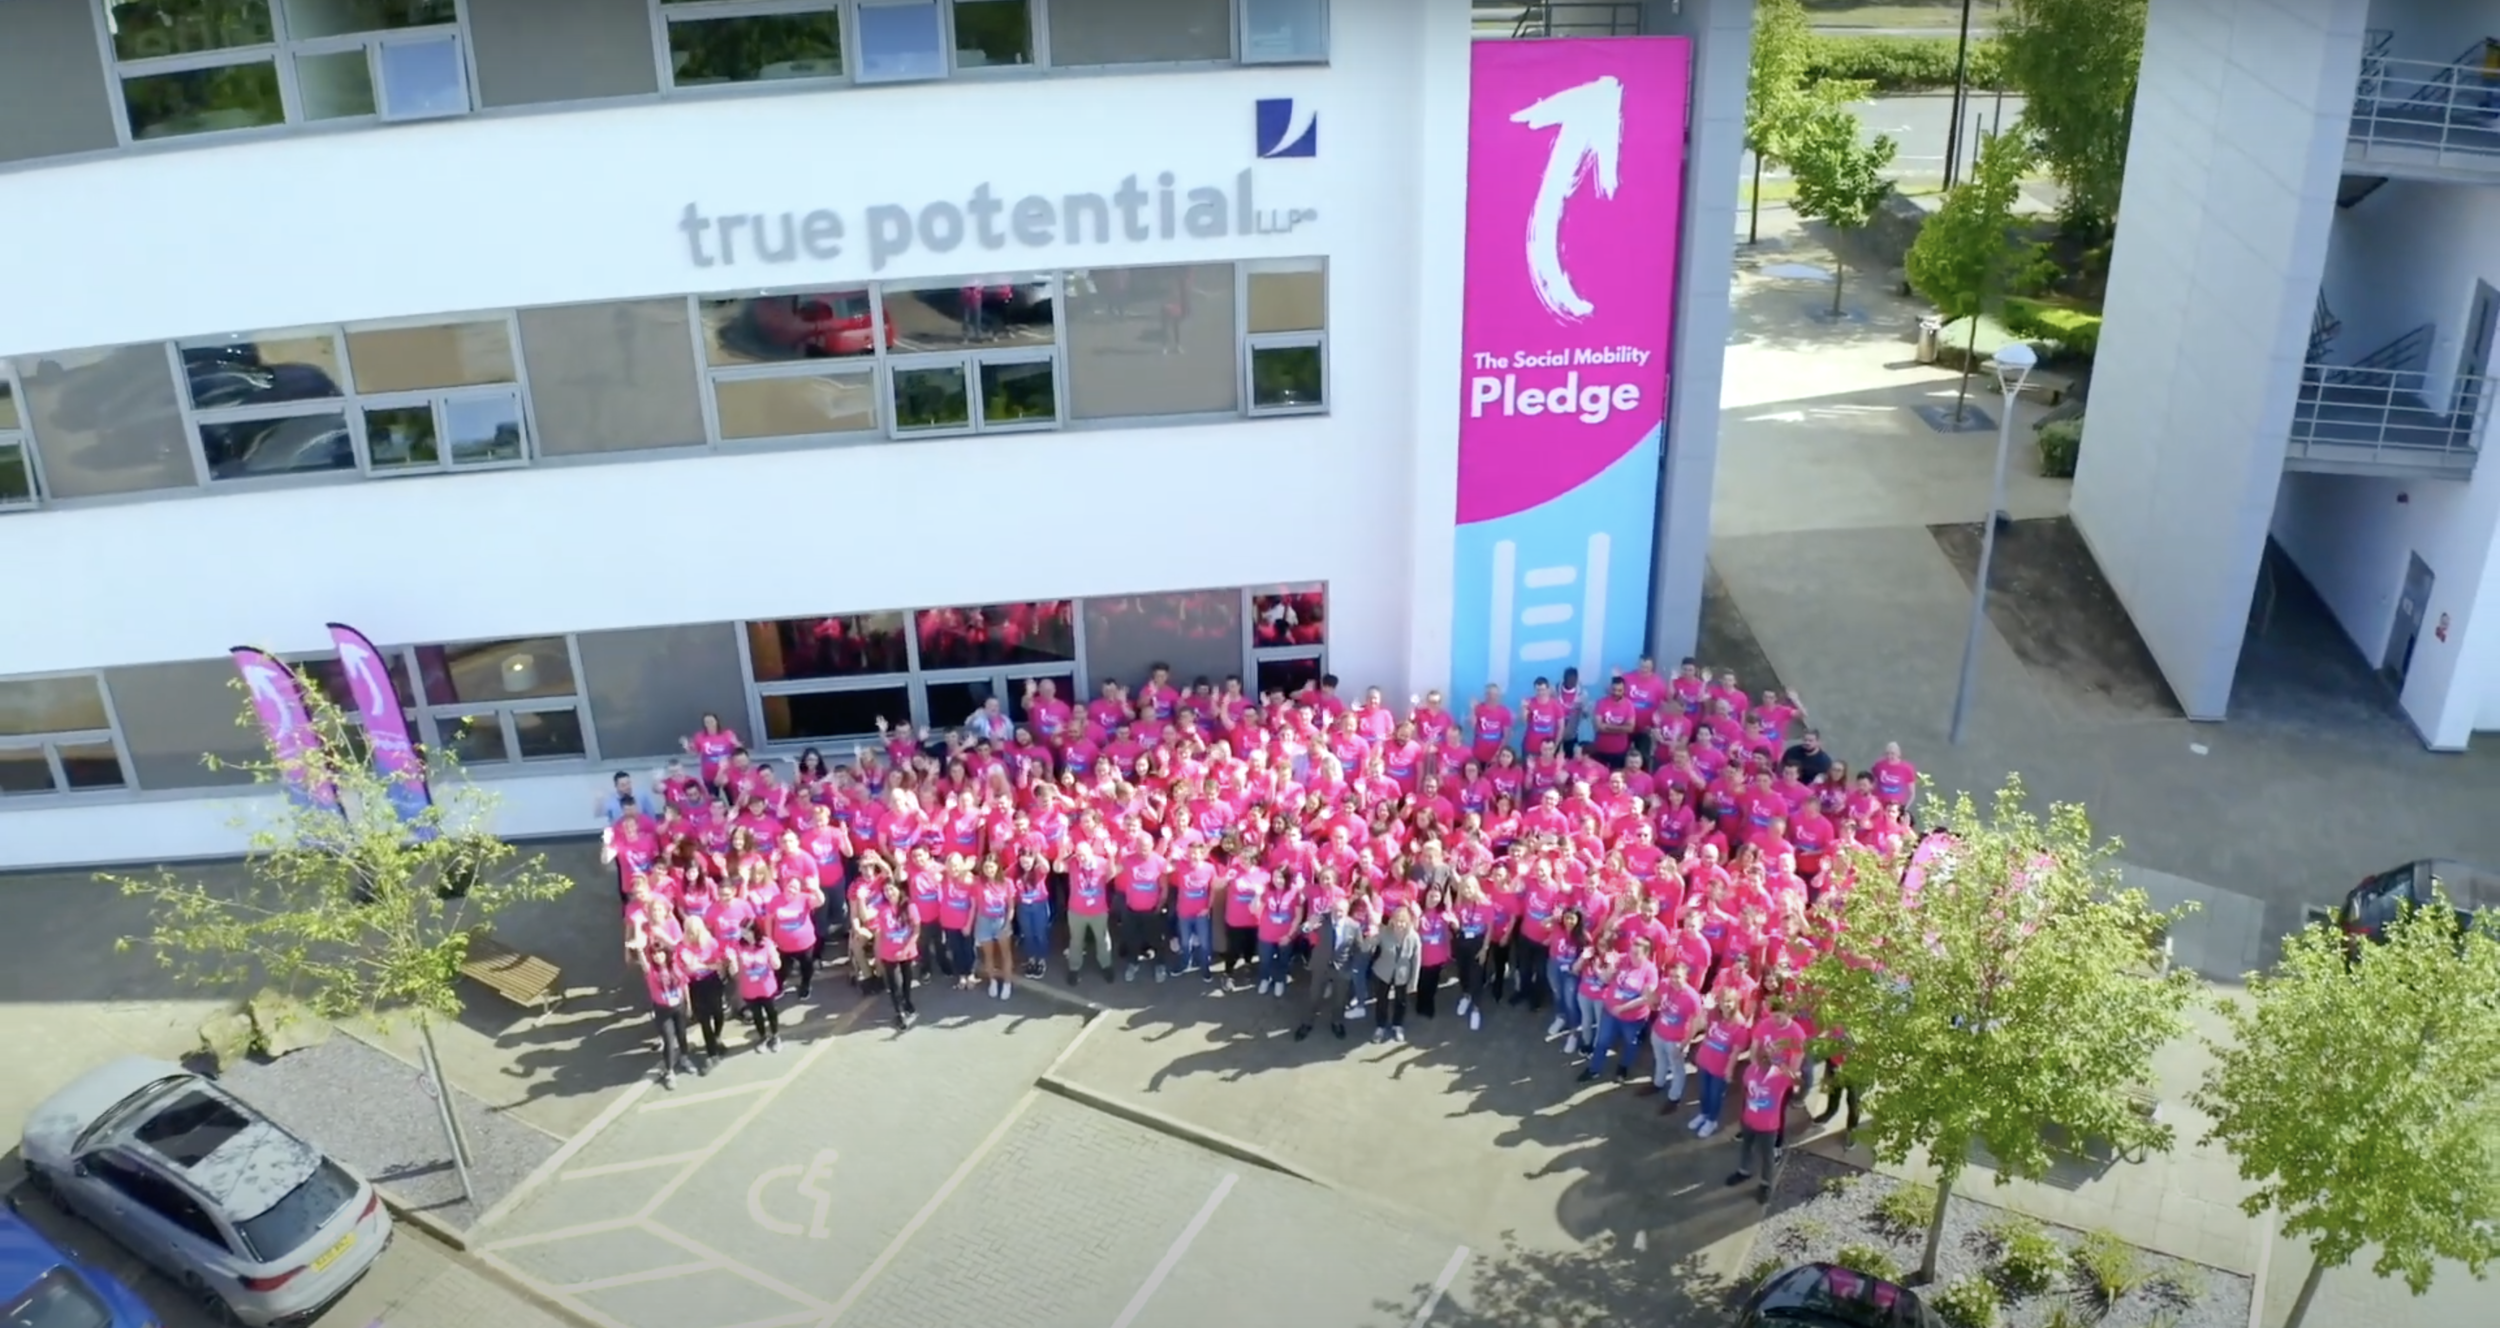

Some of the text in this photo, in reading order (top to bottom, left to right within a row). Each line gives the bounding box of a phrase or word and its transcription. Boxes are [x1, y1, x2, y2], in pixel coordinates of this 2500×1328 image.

[679, 200, 845, 268] true
[865, 166, 1254, 272] potential
[1473, 345, 1651, 370] The Social Mobility
[1470, 370, 1641, 424] Pledge
